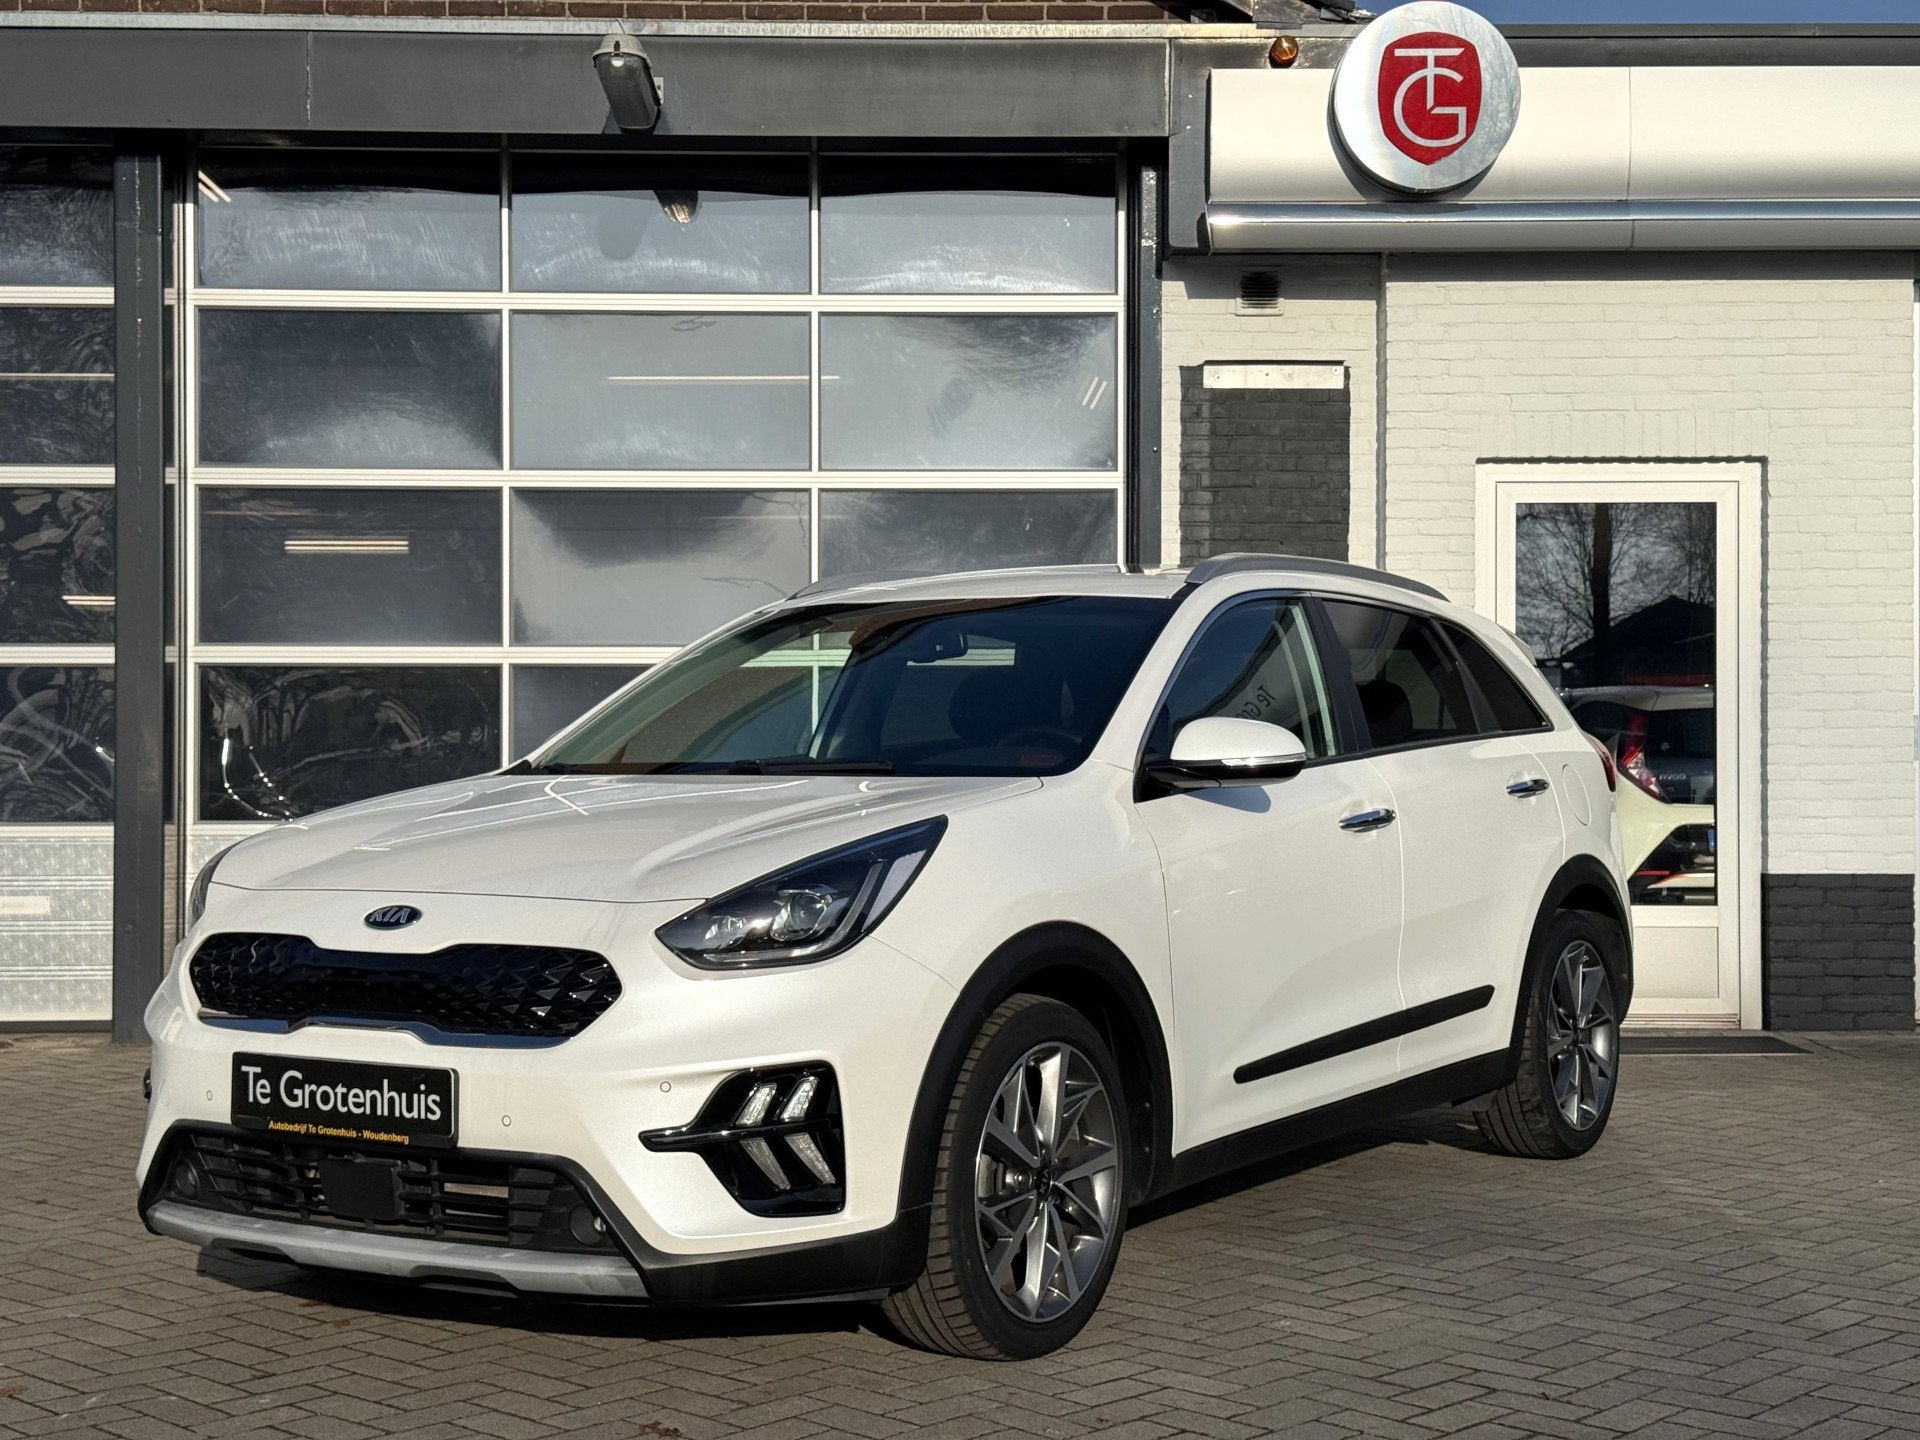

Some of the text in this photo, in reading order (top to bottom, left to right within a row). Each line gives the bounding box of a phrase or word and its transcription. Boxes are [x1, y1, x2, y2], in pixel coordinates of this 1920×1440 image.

[368, 907, 411, 924] KIA
[241, 1065, 442, 1121] Te Grotenhuis
[268, 1120, 307, 1134] Autobedrijf
[308, 1123, 317, 1134] Te
[317, 1125, 357, 1138] Grotenhuis
[362, 1129, 410, 1145] Woudenberg
